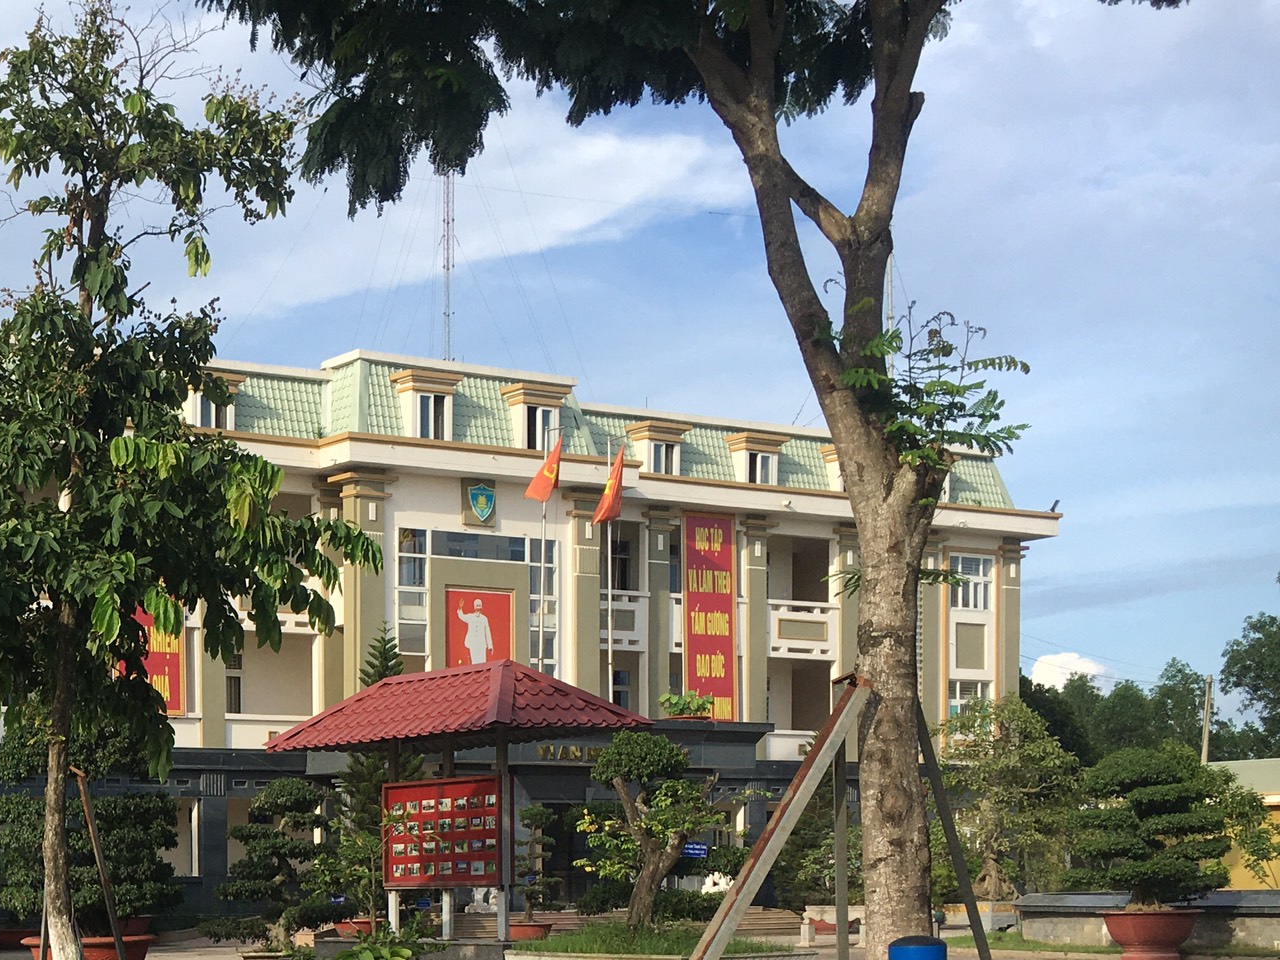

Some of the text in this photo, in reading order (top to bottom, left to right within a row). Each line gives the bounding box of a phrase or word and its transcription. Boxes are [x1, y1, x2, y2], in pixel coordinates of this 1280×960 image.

[695, 523, 723, 557] HỌC TẬP
[688, 564, 731, 595] VÀ LÀM THEO
[690, 603, 729, 636] TẤM GƯƠNG
[696, 650, 725, 683] ĐẠO ĐỨC
[713, 696, 732, 720] MINH
